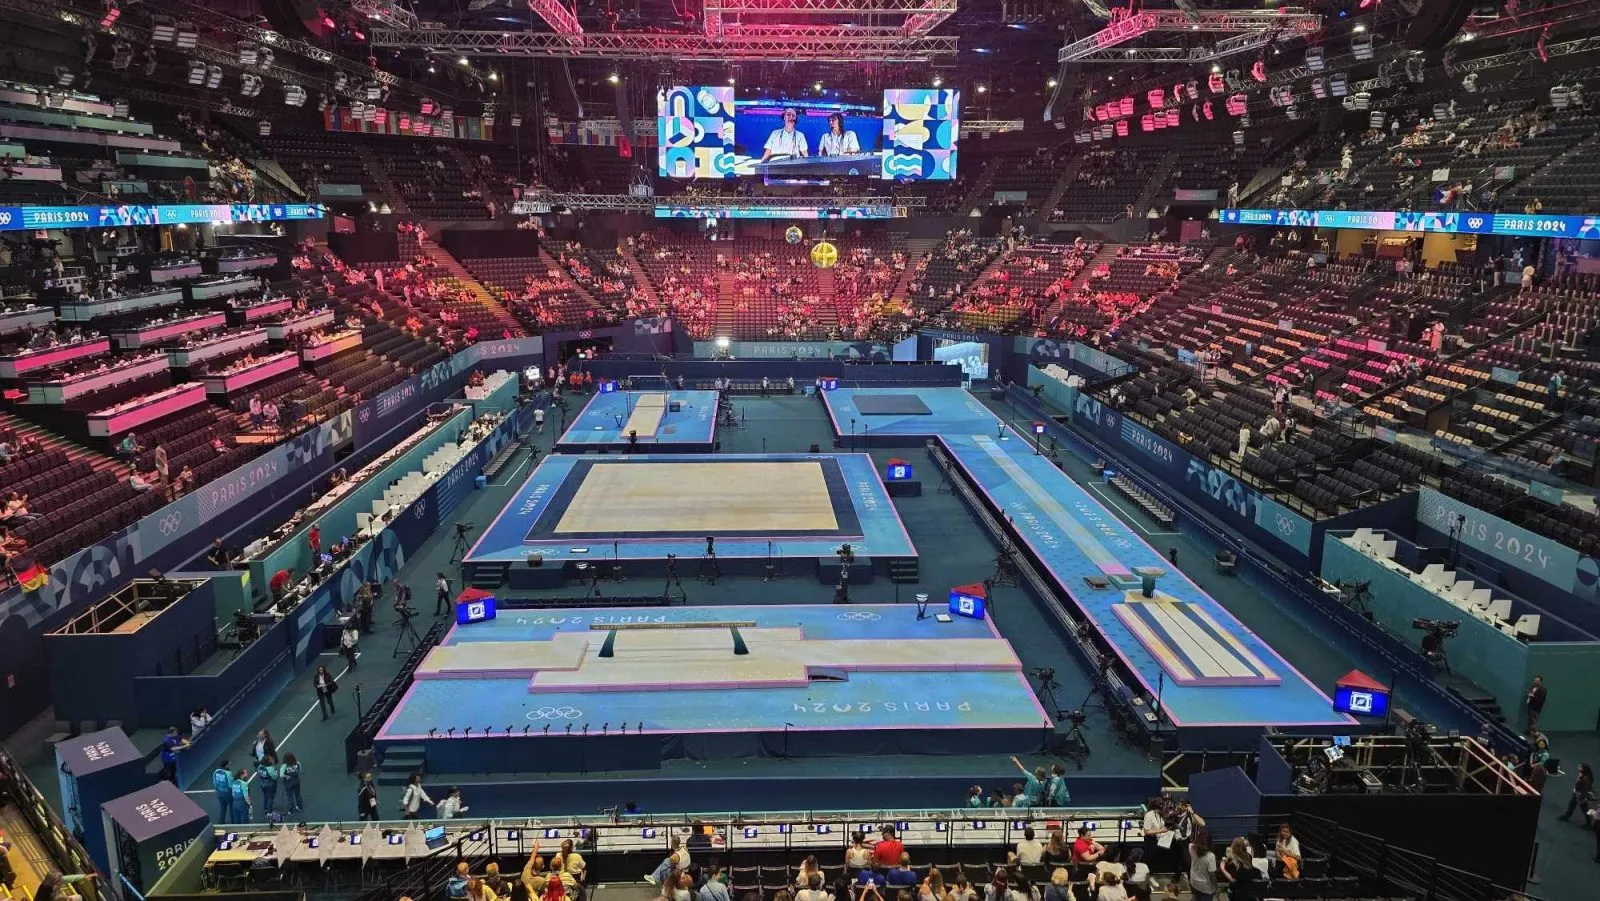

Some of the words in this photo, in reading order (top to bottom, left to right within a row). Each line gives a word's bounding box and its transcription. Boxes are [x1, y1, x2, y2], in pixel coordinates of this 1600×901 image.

[34, 212, 63, 223] PARIS
[64, 211, 89, 222] 2024
[190, 208, 209, 218] PARIS
[1347, 215, 1367, 224] PARIS
[1504, 219, 1534, 231] PARIS
[1536, 220, 1566, 232] 2024
[491, 343, 519, 354] 2024
[754, 346, 787, 354] PARIS
[791, 346, 821, 355] 2024
[383, 391, 401, 410] PARIS
[401, 383, 416, 400] 2024
[1132, 429, 1152, 450] PARIS
[1153, 441, 1173, 463] 2024
[212, 475, 247, 508] PARIS
[249, 460, 277, 487] 2024
[1436, 505, 1488, 541] PARIS
[1494, 531, 1548, 569] 2024
[516, 616, 584, 625] 2024
[593, 615, 666, 623] PARIS
[793, 701, 871, 713] 2024
[884, 701, 972, 711] PARIS
[136, 803, 161, 822] PARIS
[150, 798, 174, 817] 2024
